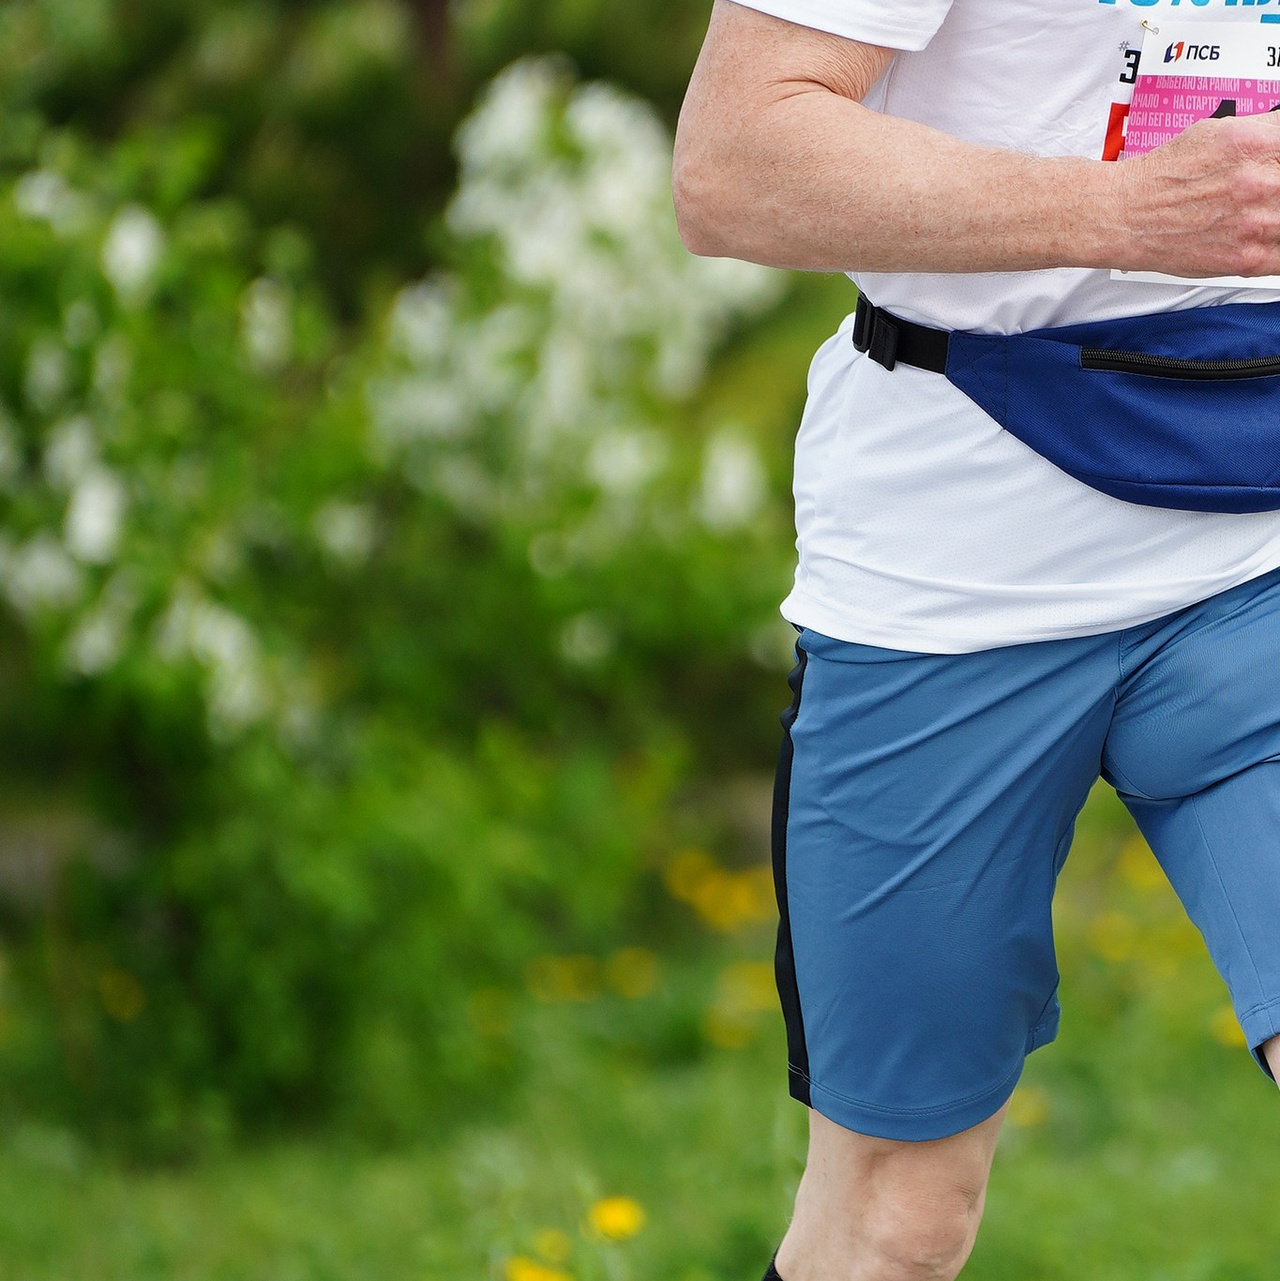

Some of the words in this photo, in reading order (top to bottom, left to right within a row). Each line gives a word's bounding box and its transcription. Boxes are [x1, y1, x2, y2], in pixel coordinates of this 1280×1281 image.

[1186, 45, 1220, 61] ПСБ
[1197, 77, 1208, 91] ЗА
[1210, 78, 1240, 93] РАМКИ
[1131, 93, 1159, 109] АЧАЛО
[1173, 95, 1185, 110] НА
[1148, 112, 1164, 127] БЕГ
[1165, 113, 1172, 128] В
